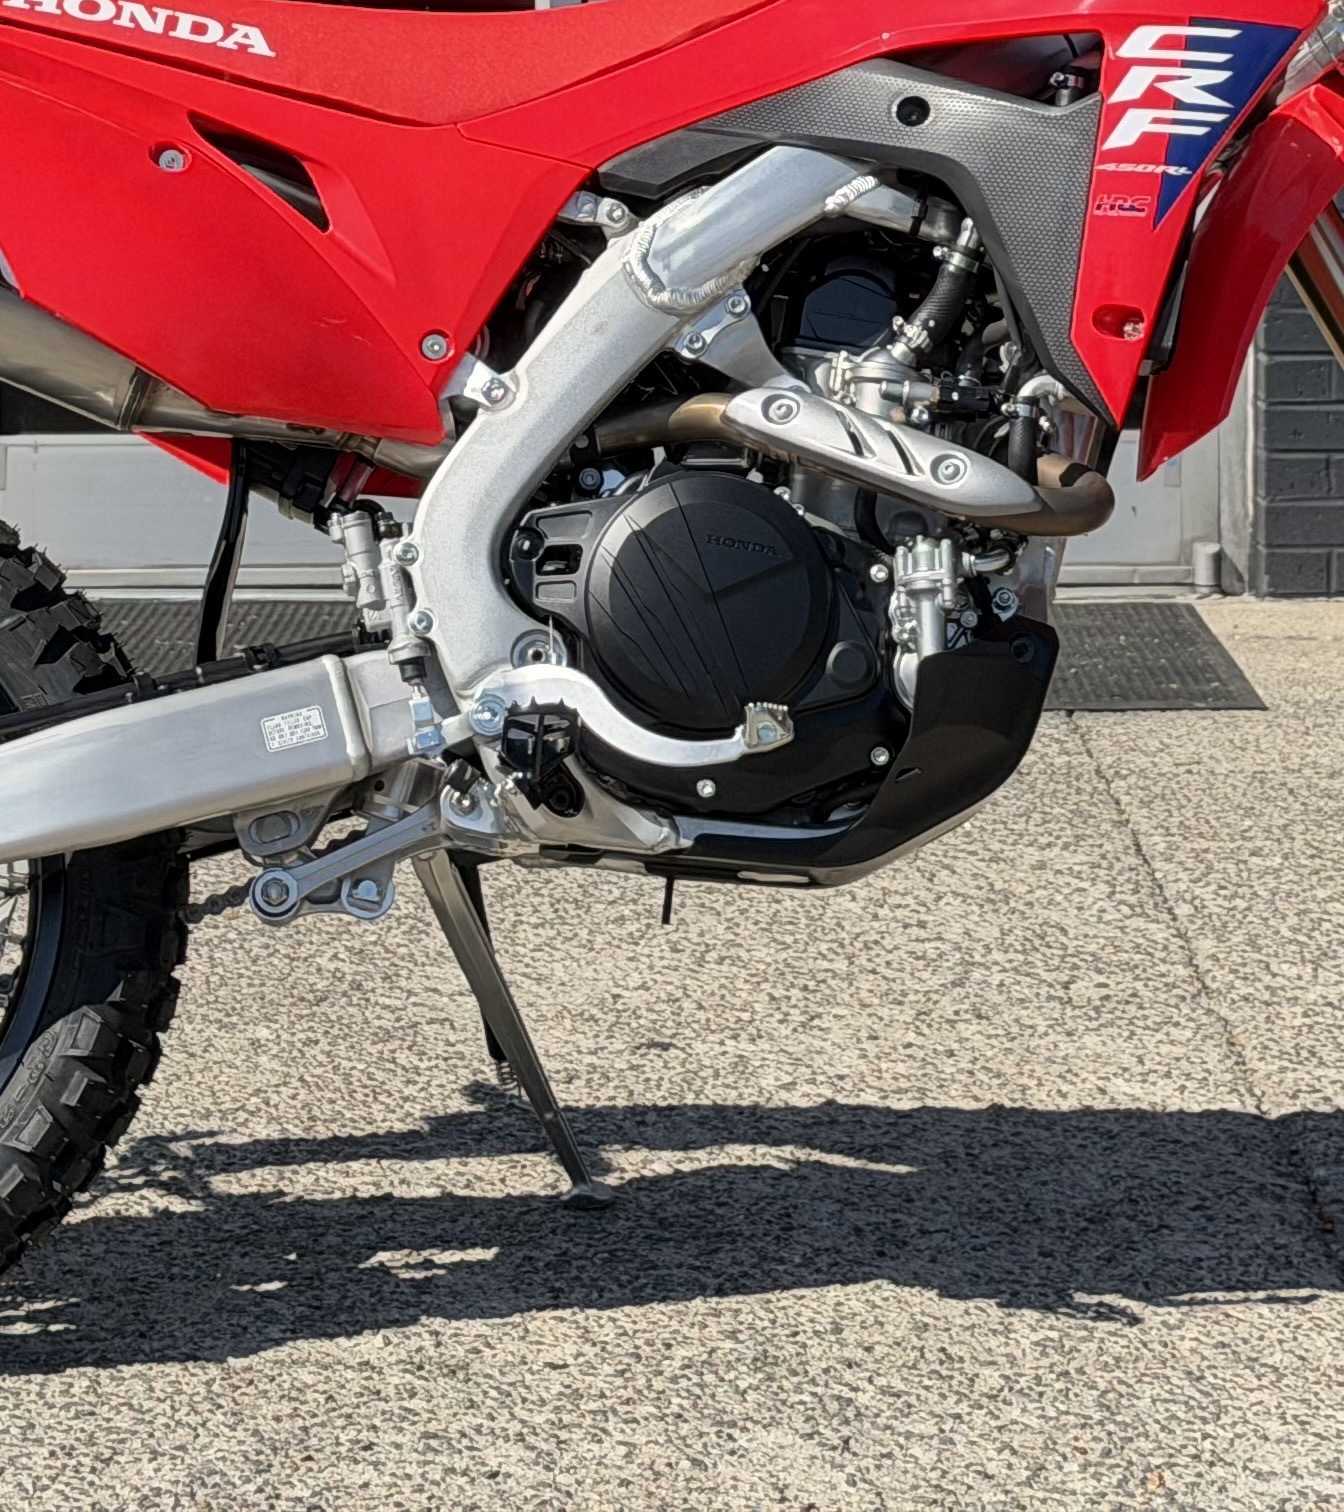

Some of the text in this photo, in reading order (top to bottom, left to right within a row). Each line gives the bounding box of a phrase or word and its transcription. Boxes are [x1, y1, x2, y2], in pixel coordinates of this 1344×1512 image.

[1101, 25, 1243, 150] CRF
[1093, 194, 1152, 217] HRC
[705, 533, 784, 559] HONDA
